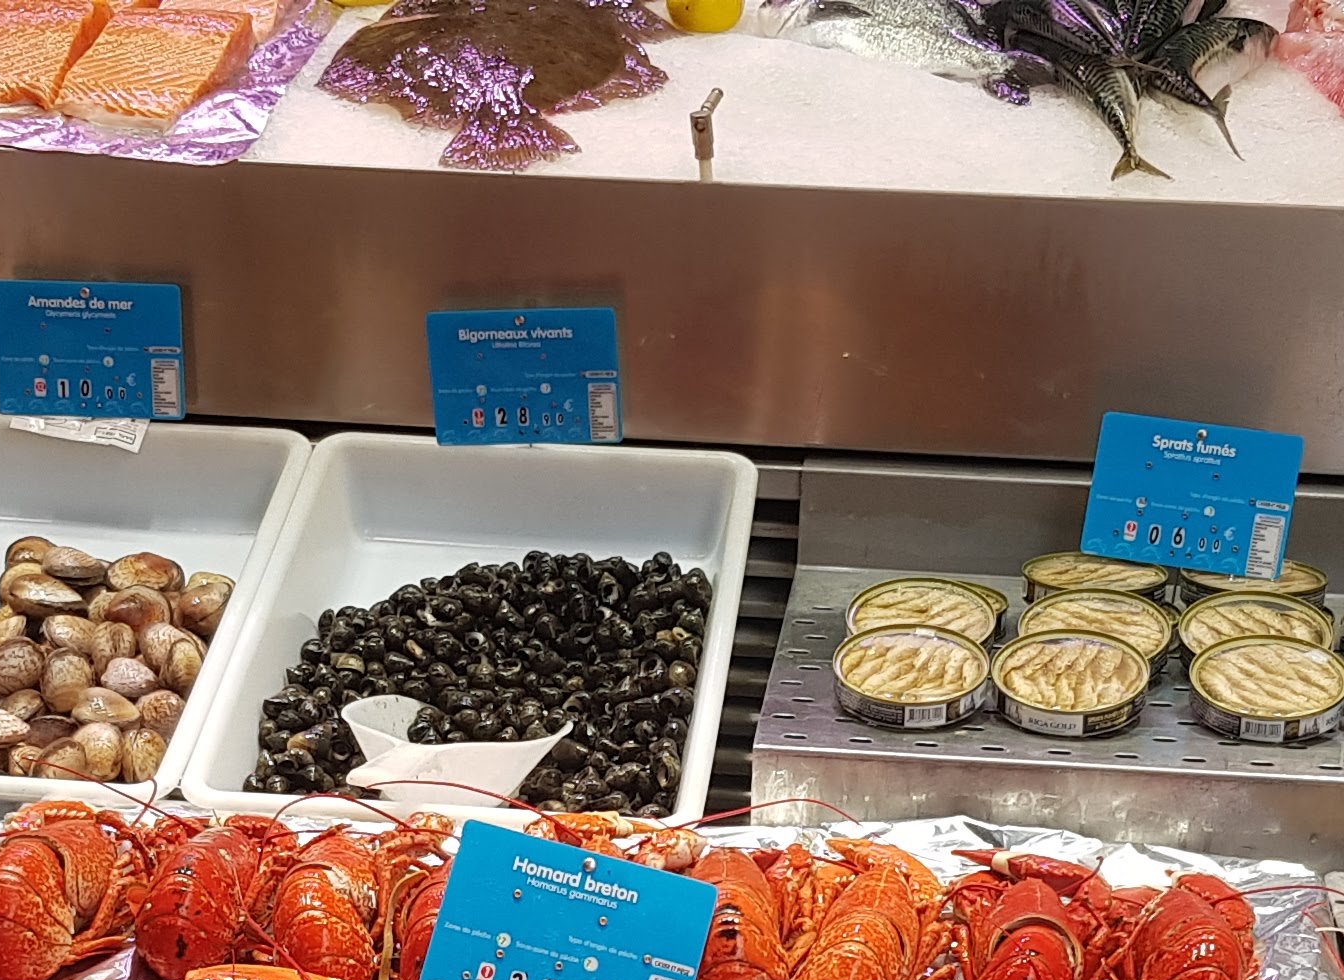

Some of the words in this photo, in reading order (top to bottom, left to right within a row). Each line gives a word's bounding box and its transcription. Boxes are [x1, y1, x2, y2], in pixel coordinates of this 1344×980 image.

[27, 295, 86, 309] Amandes
[89, 297, 105, 310] de
[108, 300, 134, 310] mer
[458, 328, 528, 343] Bigorneaux
[531, 326, 573, 338] vivants
[1152, 434, 1193, 452] Sprats
[1196, 440, 1237, 457] fumés
[512, 855, 582, 888] Homard
[584, 875, 639, 904] breton
[526, 876, 567, 896] Homarus
[568, 889, 618, 909] gammarus
